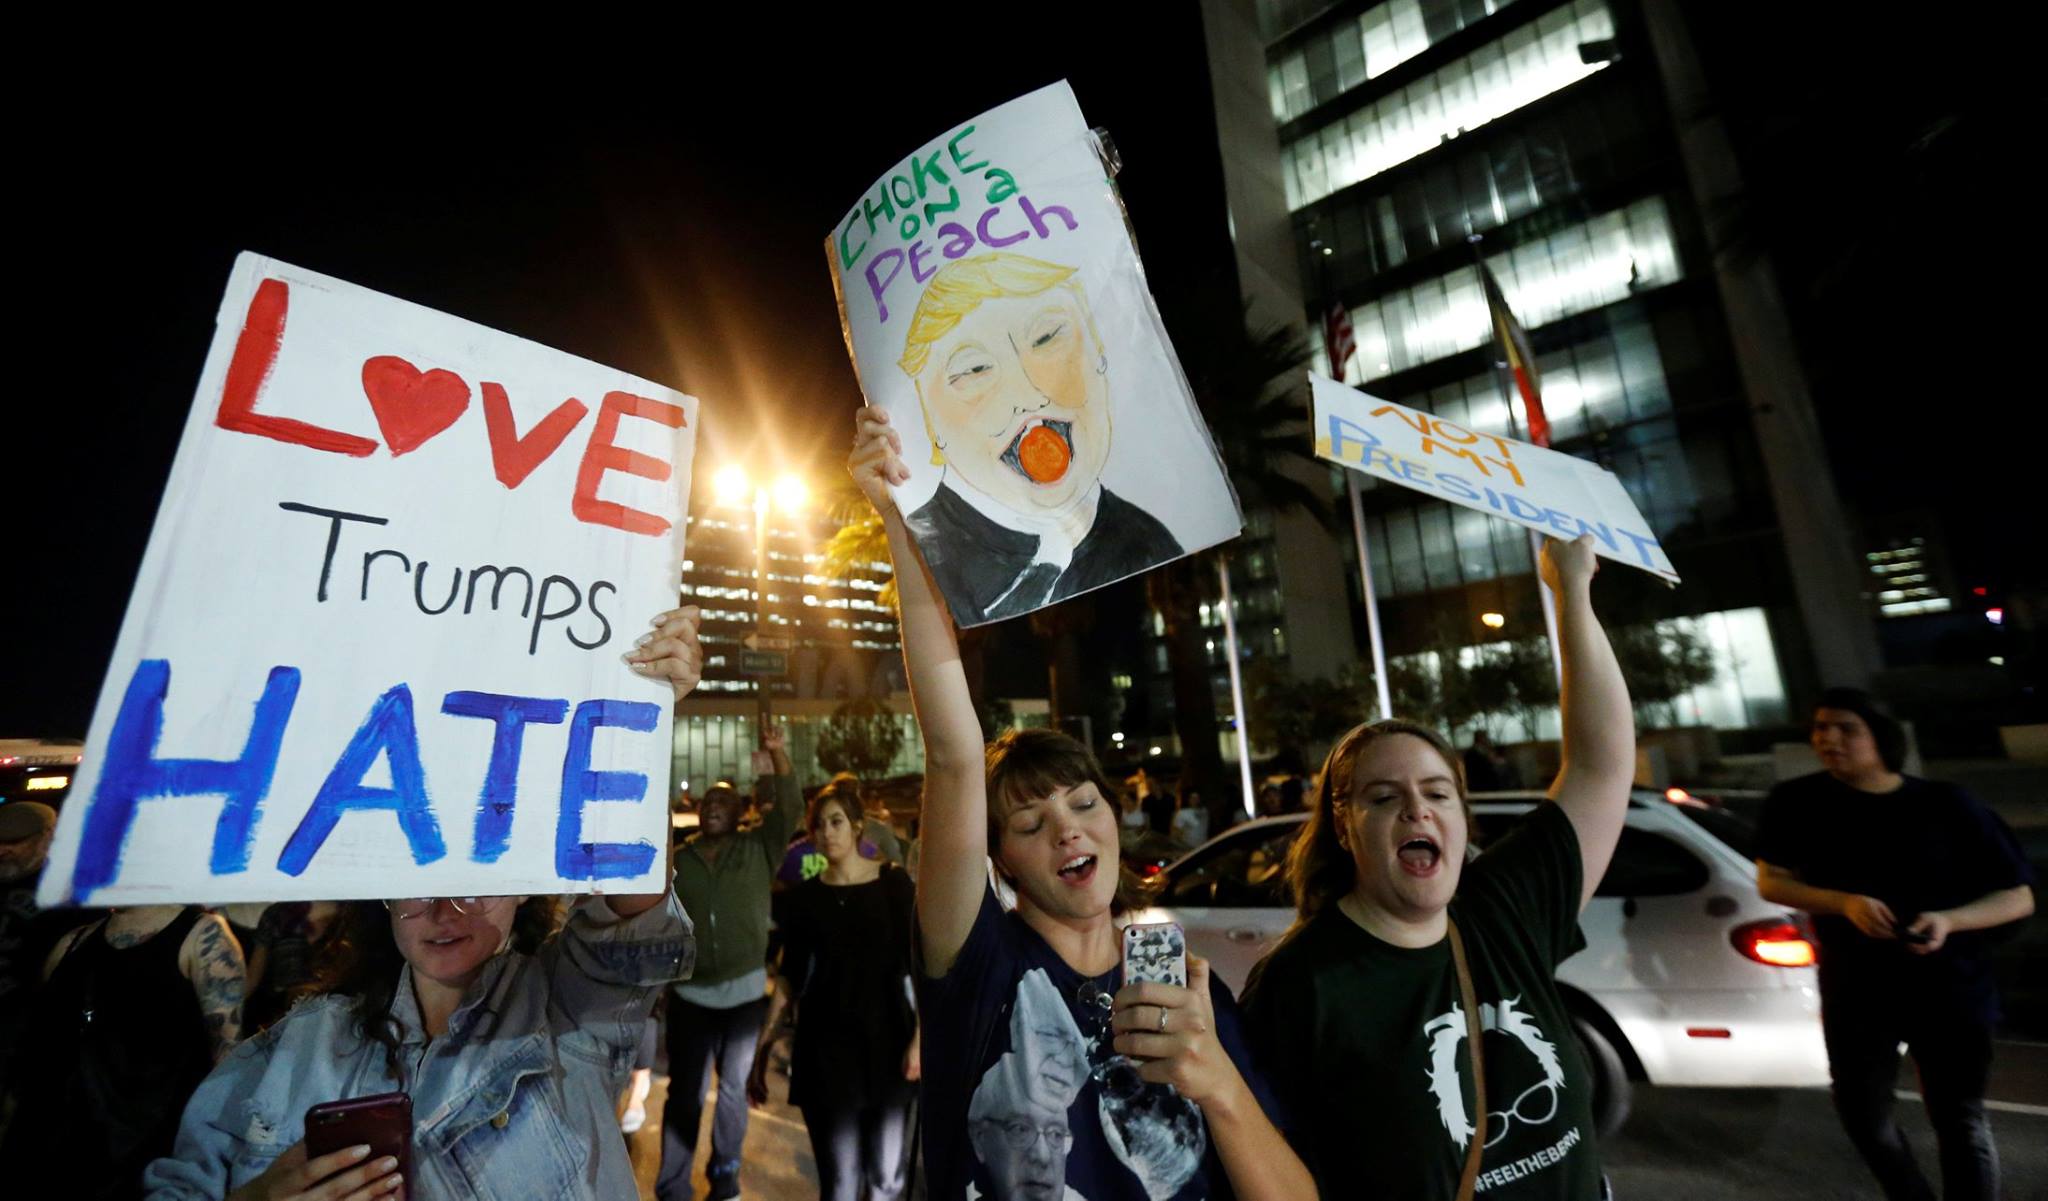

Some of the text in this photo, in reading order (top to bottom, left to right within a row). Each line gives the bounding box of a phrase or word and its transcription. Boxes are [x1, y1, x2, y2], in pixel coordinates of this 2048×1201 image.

[840, 125, 989, 271] CHOKE
[900, 186, 960, 240] ON
[1328, 415, 1661, 568] PRESIDENT
[1369, 405, 1520, 458] NOT
[1422, 436, 1525, 488] MY
[279, 501, 617, 655] Trumps
[72, 658, 662, 906] HATE
